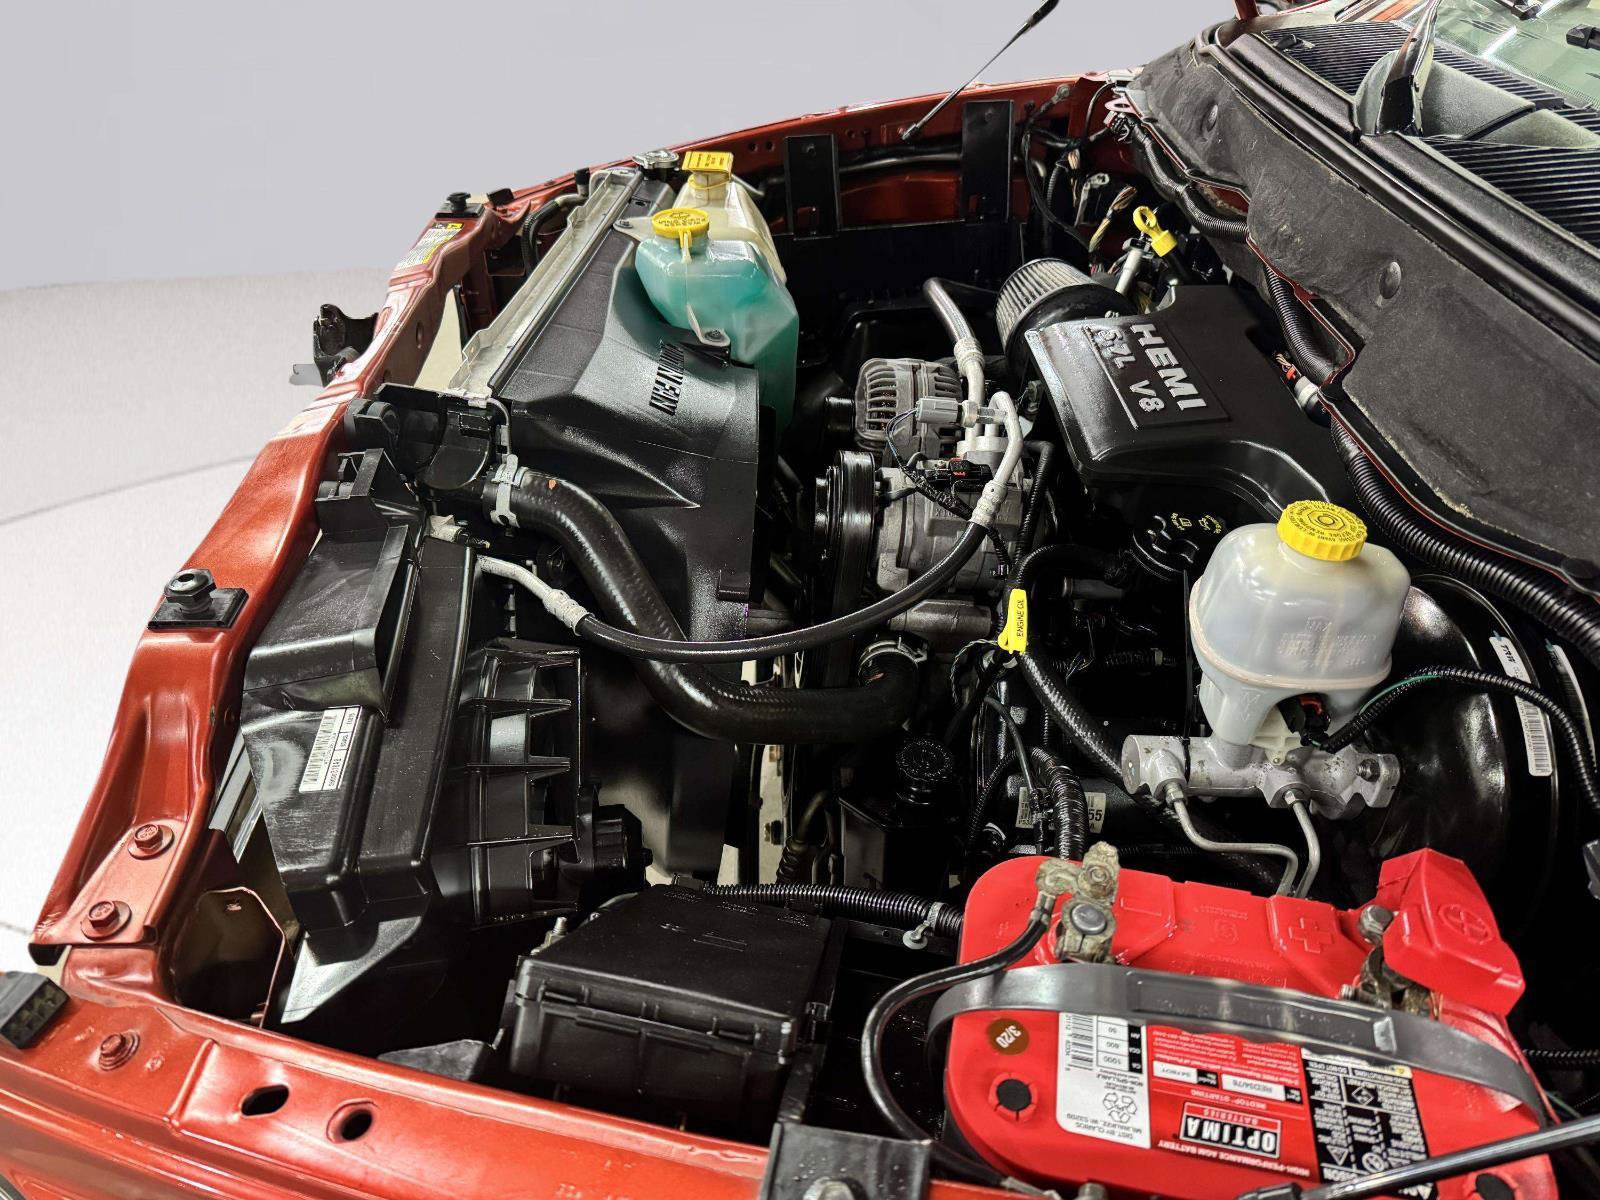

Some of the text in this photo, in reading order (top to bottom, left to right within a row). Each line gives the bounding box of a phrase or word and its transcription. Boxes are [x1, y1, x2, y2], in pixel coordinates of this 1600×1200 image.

[1130, 323, 1207, 411] HEMI
[1129, 379, 1165, 412] V8
[1016, 609, 1025, 637] ENGINE
[996, 1025, 1022, 1048] 3/20
[1103, 1055, 1121, 1064] 1000
[1190, 1088, 1230, 1102] STARTING
[1202, 1107, 1258, 1125] BATTERIES
[1185, 1115, 1276, 1153] OPTIMA
[1157, 1139, 1196, 1153] BATTERY
